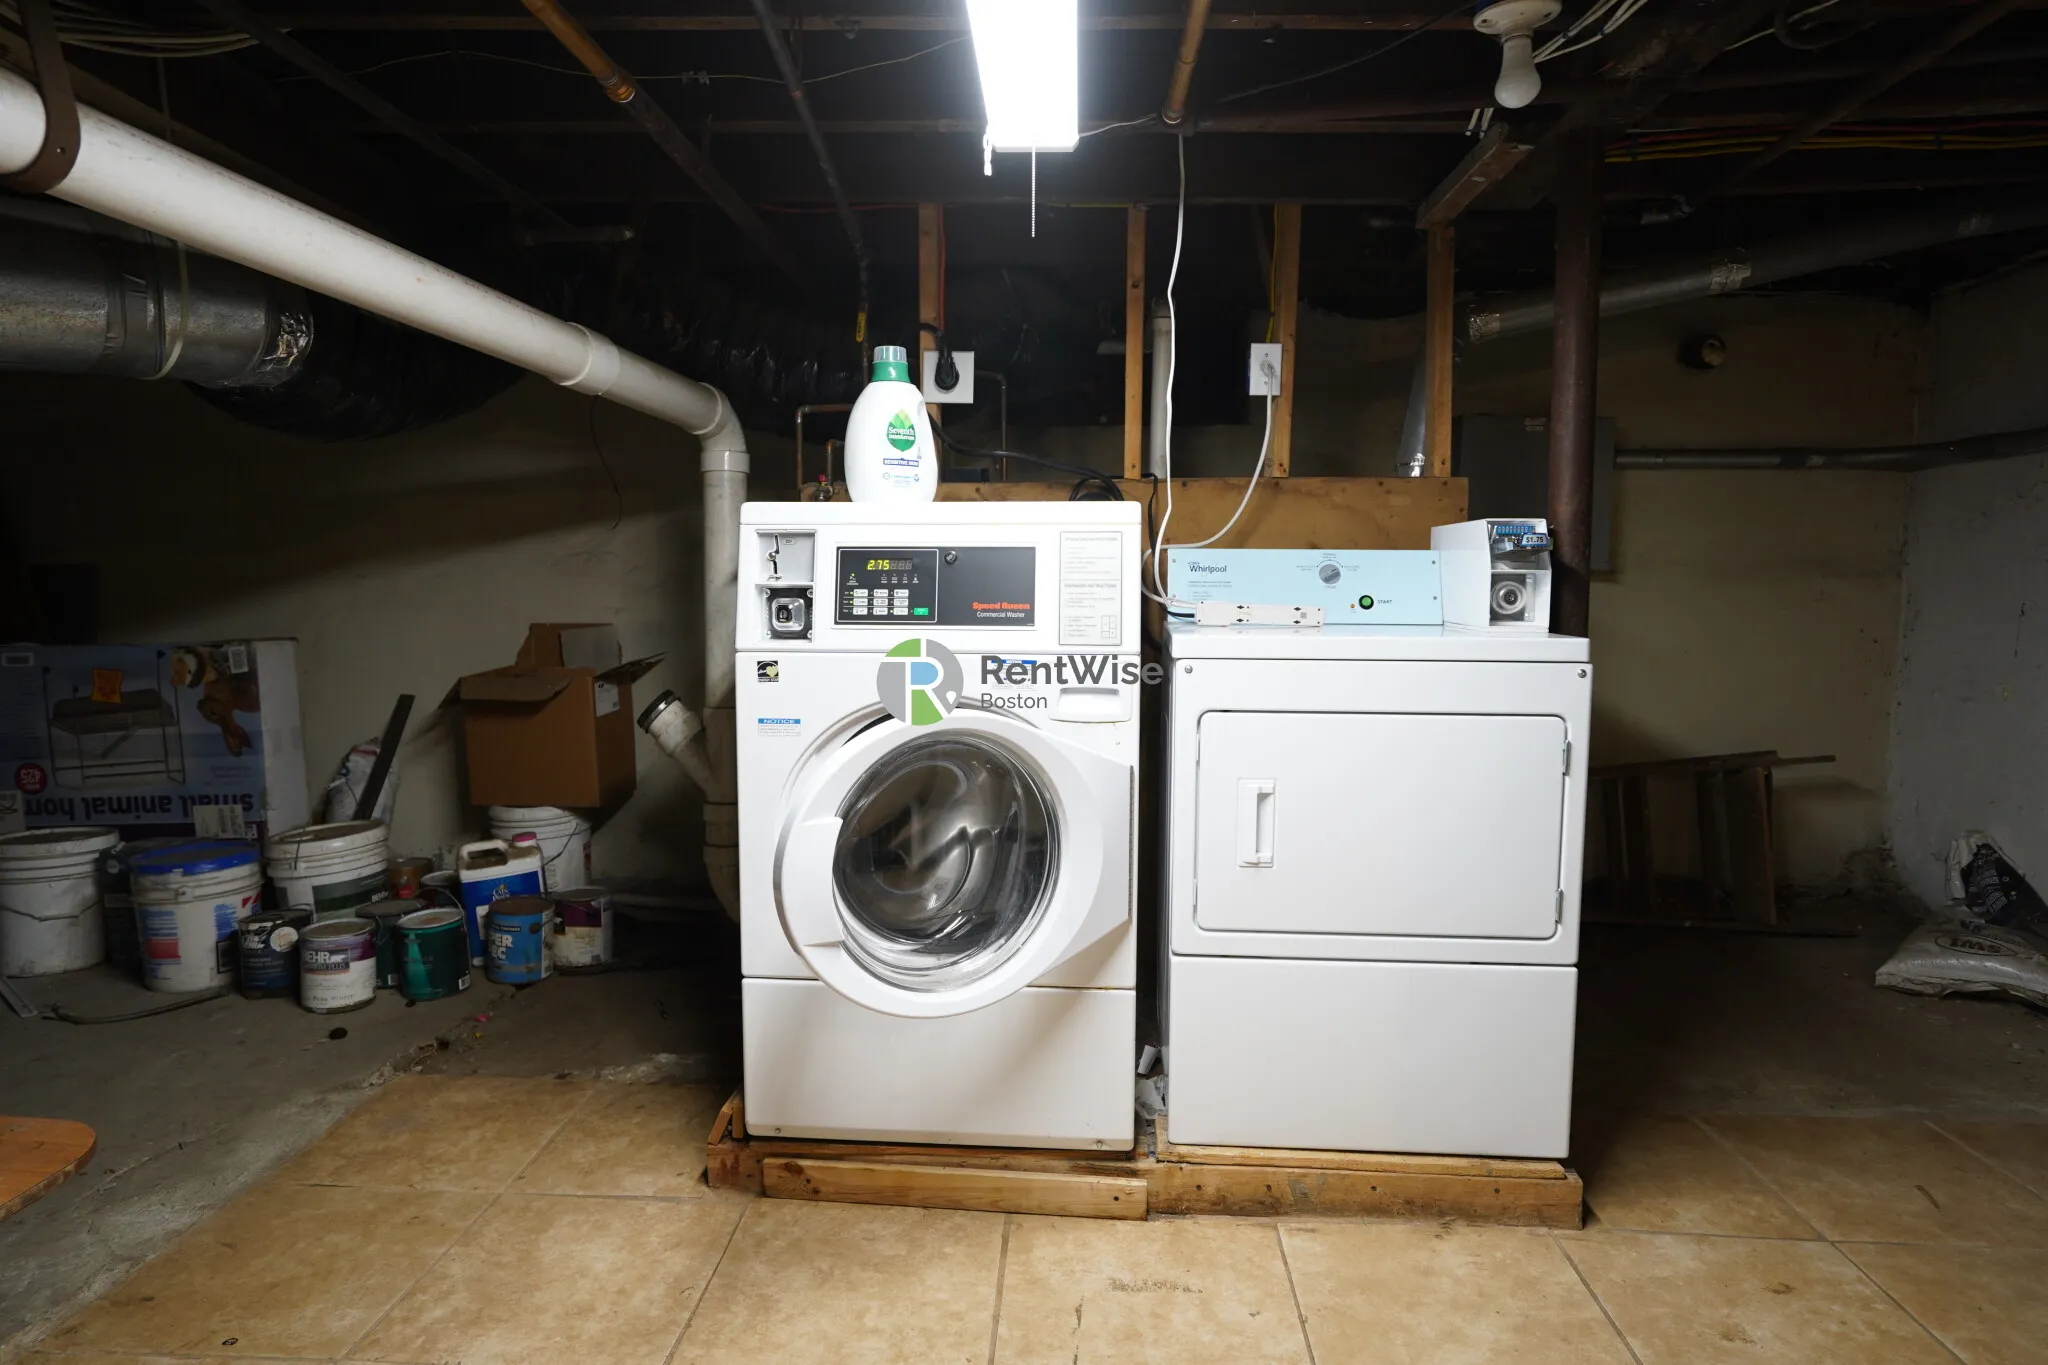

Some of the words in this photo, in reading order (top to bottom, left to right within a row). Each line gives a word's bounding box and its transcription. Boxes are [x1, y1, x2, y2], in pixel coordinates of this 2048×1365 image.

[888, 427, 915, 435] Seventh
[866, 559, 890, 571] 2.75
[1188, 564, 1227, 575] Whirlpool
[972, 602, 1001, 611] Speed
[1001, 602, 1031, 610] Queen
[20, 769, 41, 783] 425
[81, 796, 173, 821] animal
